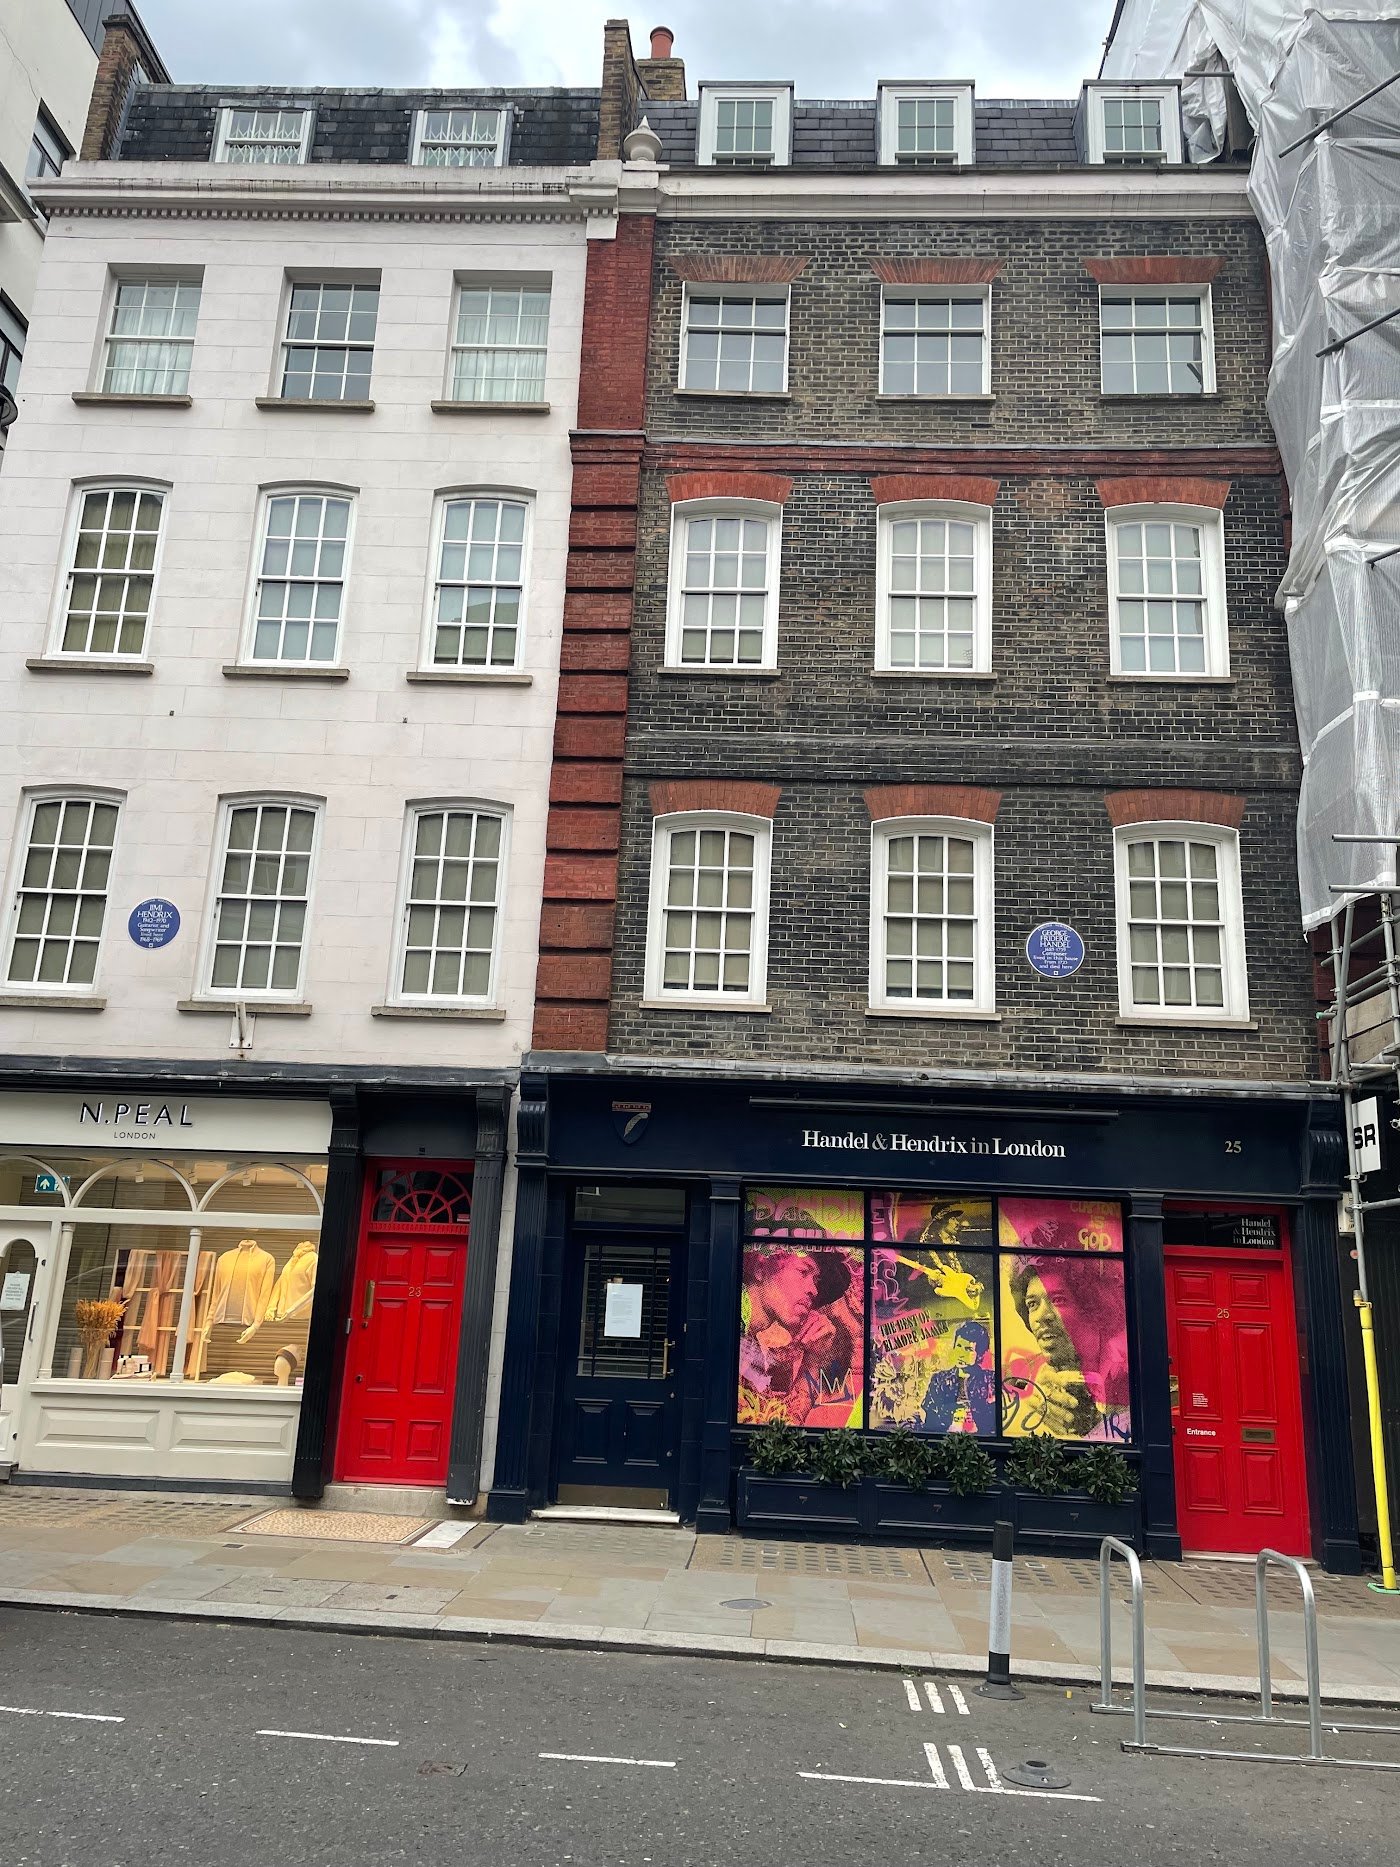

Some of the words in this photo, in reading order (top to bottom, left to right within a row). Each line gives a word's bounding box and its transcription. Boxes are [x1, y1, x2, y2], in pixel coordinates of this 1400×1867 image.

[113, 1132, 156, 1140] LONDON
[801, 1130, 870, 1150] Handel
[871, 1132, 889, 1150] &
[889, 1133, 969, 1153] Hendrix
[970, 1137, 991, 1154] in
[991, 1137, 1067, 1157] London
[1224, 1140, 1242, 1153] 25
[1241, 1218, 1271, 1227] Handel
[1241, 1227, 1276, 1236] Hendrix
[1078, 1228, 1112, 1251] GOD
[1241, 1235, 1275, 1245] London
[408, 1286, 421, 1297] 23
[1216, 1307, 1230, 1319] 25
[878, 1321, 897, 1337] THE
[896, 1313, 919, 1332] BEST
[918, 1310, 931, 1324] OF
[882, 1330, 919, 1352] ELMORE
[1186, 1427, 1217, 1436] Entrance
